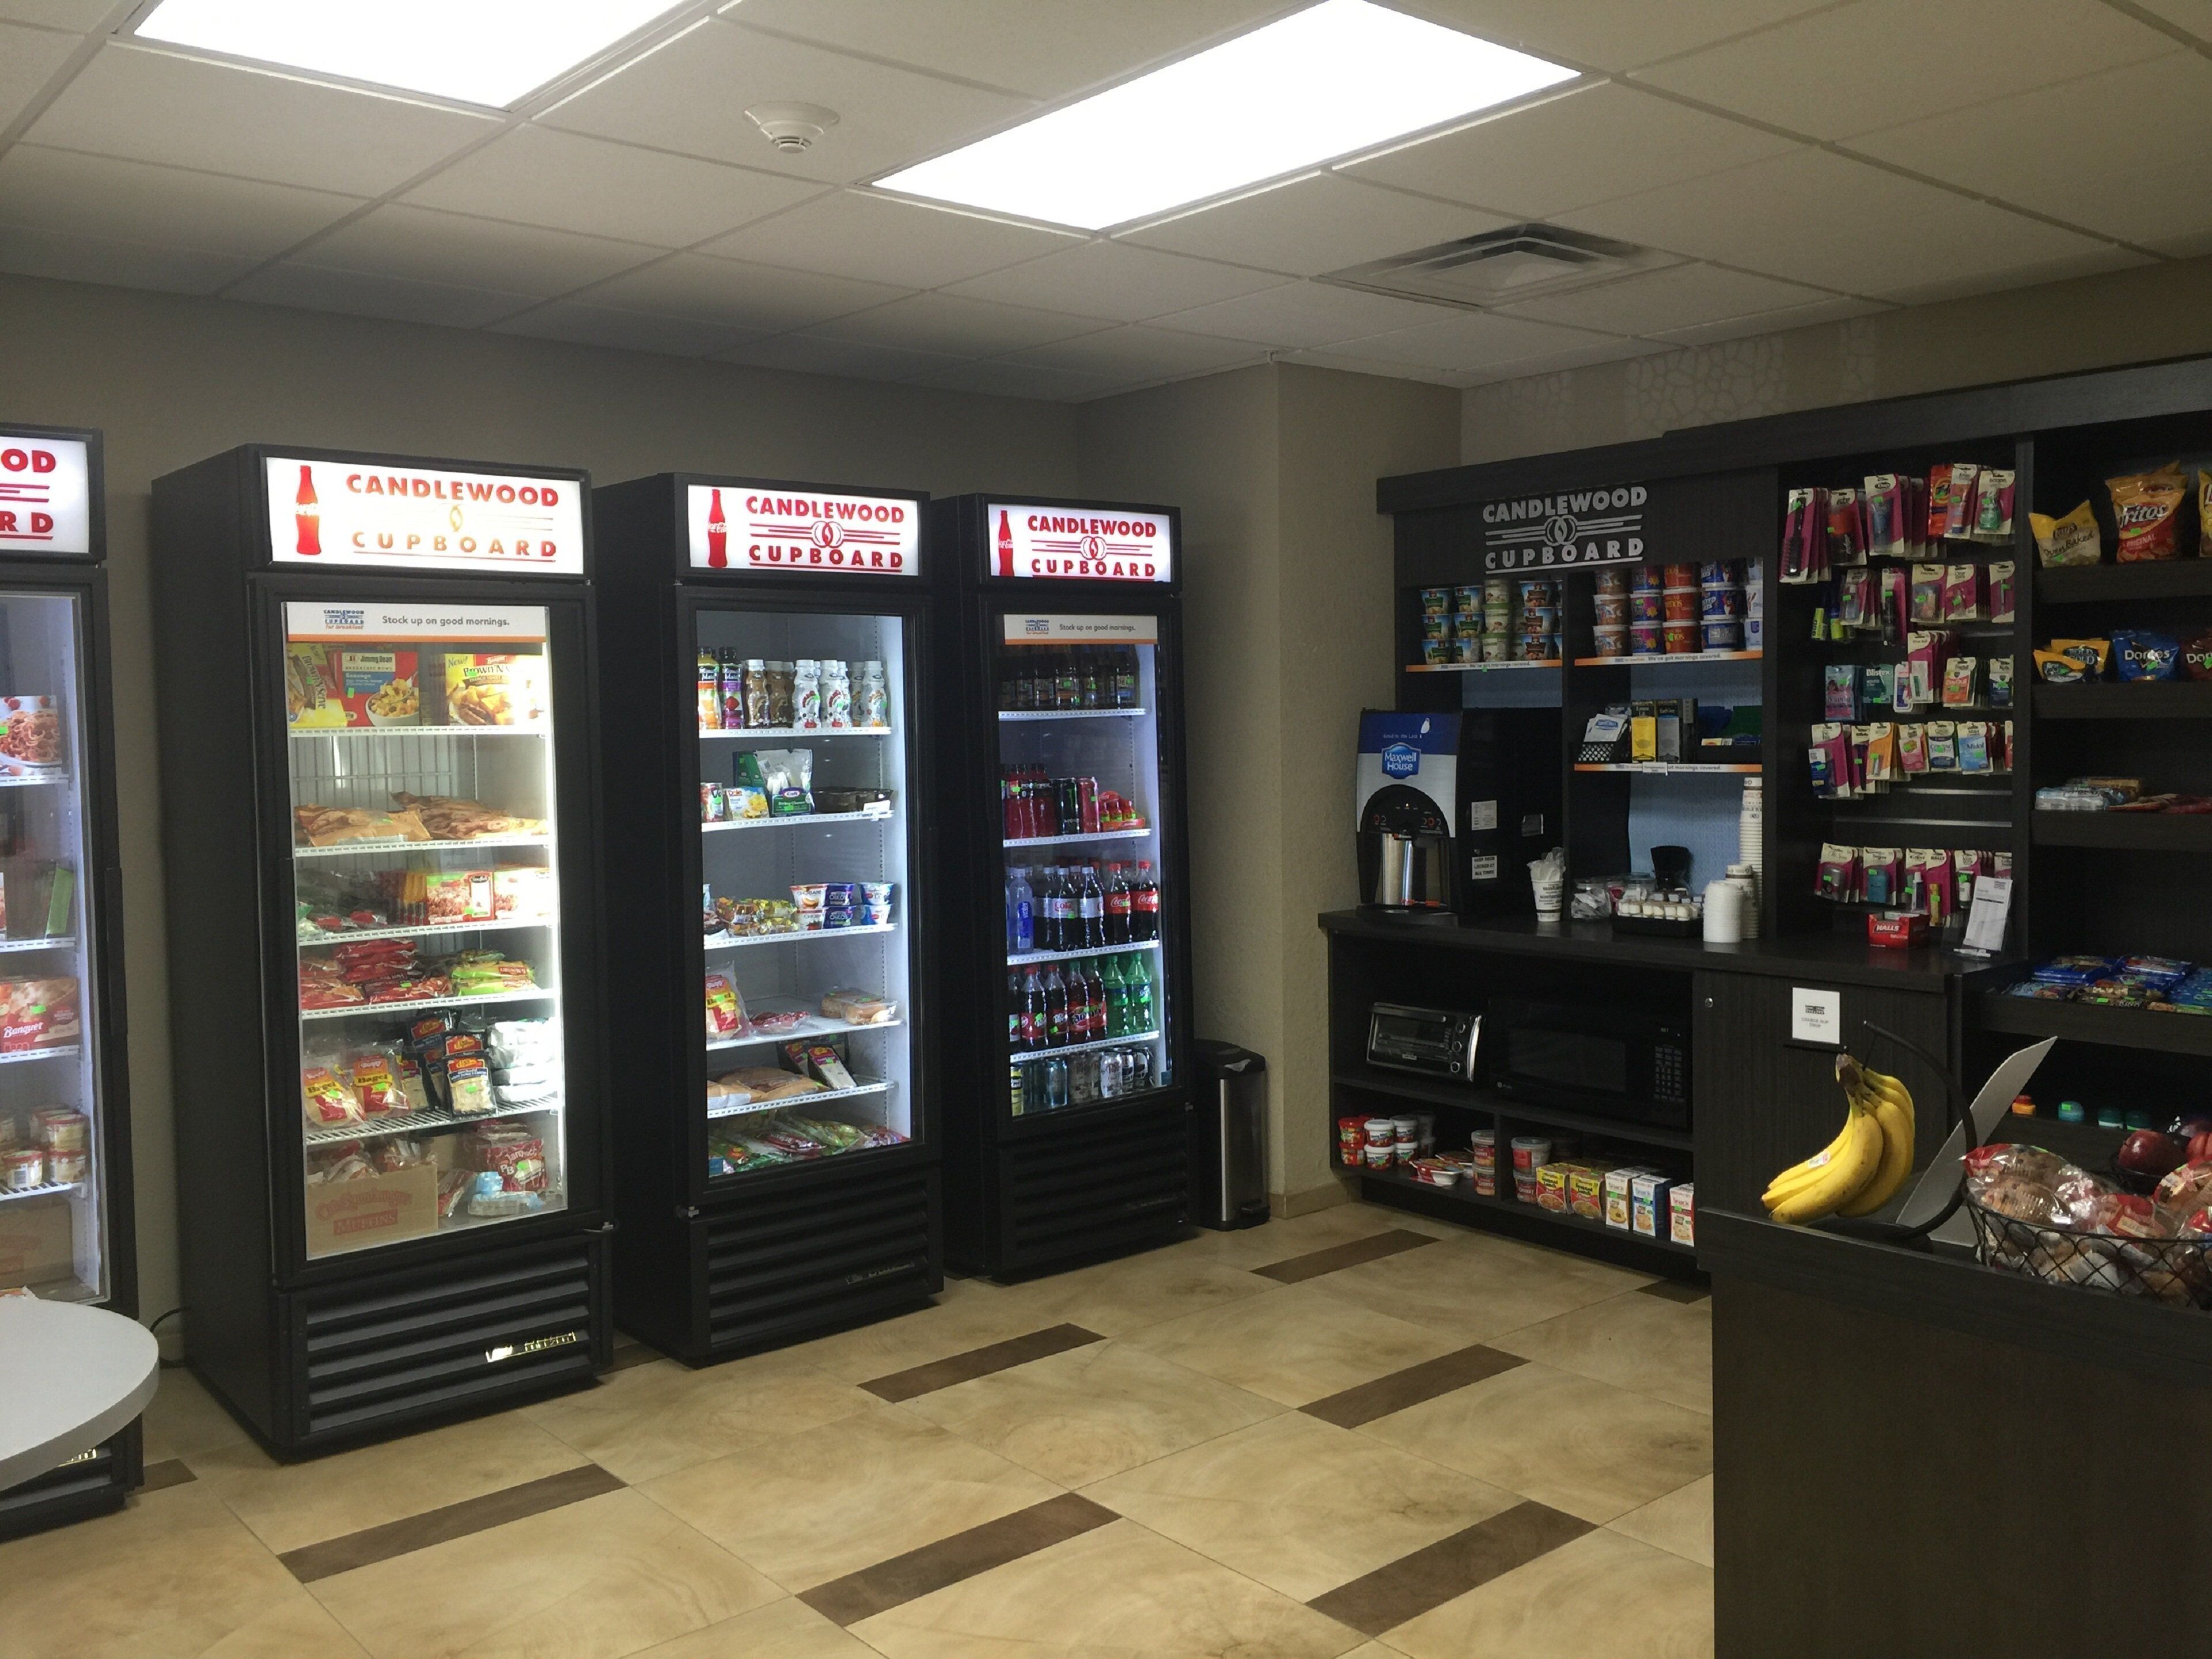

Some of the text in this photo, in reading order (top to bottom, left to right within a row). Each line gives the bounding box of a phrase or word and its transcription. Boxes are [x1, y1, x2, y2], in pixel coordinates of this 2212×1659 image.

[346, 474, 559, 507] CANDLEWOOD
[746, 496, 904, 523] CANDLEWOOD
[1483, 486, 1647, 522] CANDLEWOOD
[2120, 504, 2167, 529] Fritos
[1028, 515, 1157, 537] CANDLEWOOD
[352, 531, 556, 557] CUPBOARD
[749, 545, 903, 568] CUPBOARD
[1485, 538, 1644, 570] CUPBOARD
[1031, 559, 1156, 577] CUPBOARD
[382, 616, 408, 624] Stock
[411, 618, 423, 626] up
[440, 616, 463, 627] good
[465, 617, 510, 627] mornings.
[448, 656, 468, 668] New!
[1866, 668, 1891, 676] Blistex
[1384, 752, 1416, 763] Maxwell
[1387, 761, 1413, 771] House
[4, 1022, 44, 1038] Banquet
[307, 1081, 337, 1094] Bagel
[358, 1074, 388, 1084] Bagel
[1673, 1197, 1690, 1206] Snack
